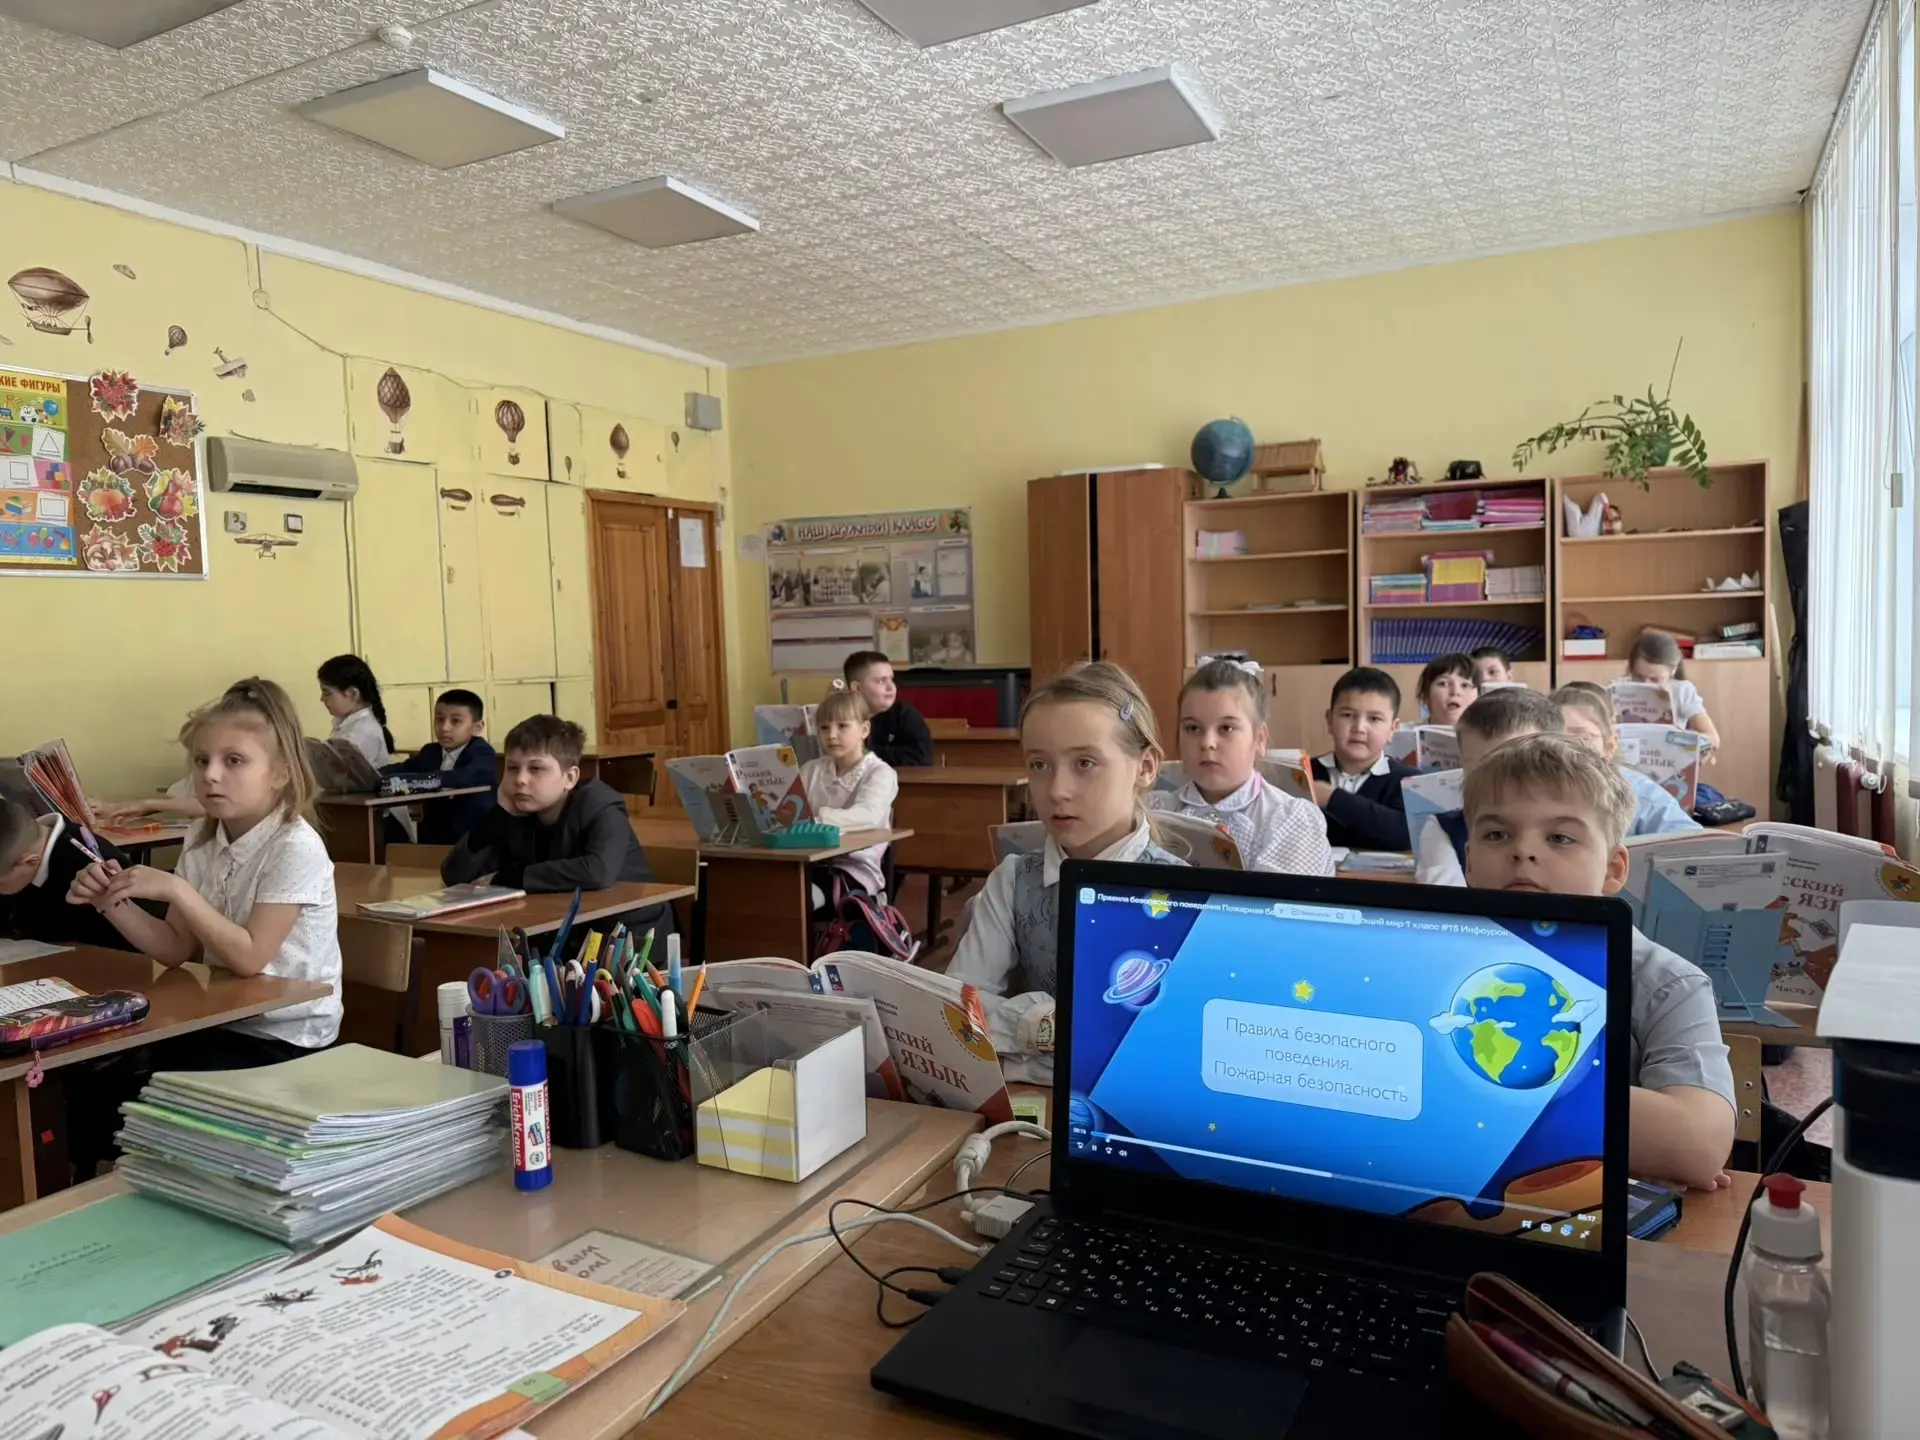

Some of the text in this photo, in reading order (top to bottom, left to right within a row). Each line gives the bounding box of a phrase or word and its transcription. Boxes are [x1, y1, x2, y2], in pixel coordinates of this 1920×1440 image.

[20, 378, 60, 393] ФИГУРЫ
[799, 525, 827, 541] НАШ
[893, 515, 936, 536] КЛАСС
[1097, 893, 1129, 903] Правила
[1130, 896, 1178, 908] безопасного
[1179, 902, 1221, 911] поведения
[1222, 904, 1263, 915] Пожарная
[1385, 921, 1403, 929] мир
[1413, 922, 1440, 931] класс
[1461, 925, 1509, 937] Инфоурок
[1226, 1016, 1396, 1053] Правила безопасного
[901, 1048, 971, 1094] язык
[1265, 1049, 1352, 1070] поведения.
[1214, 1060, 1408, 1103] Пожарная безопасность
[512, 1092, 522, 1166] ErichKrause
